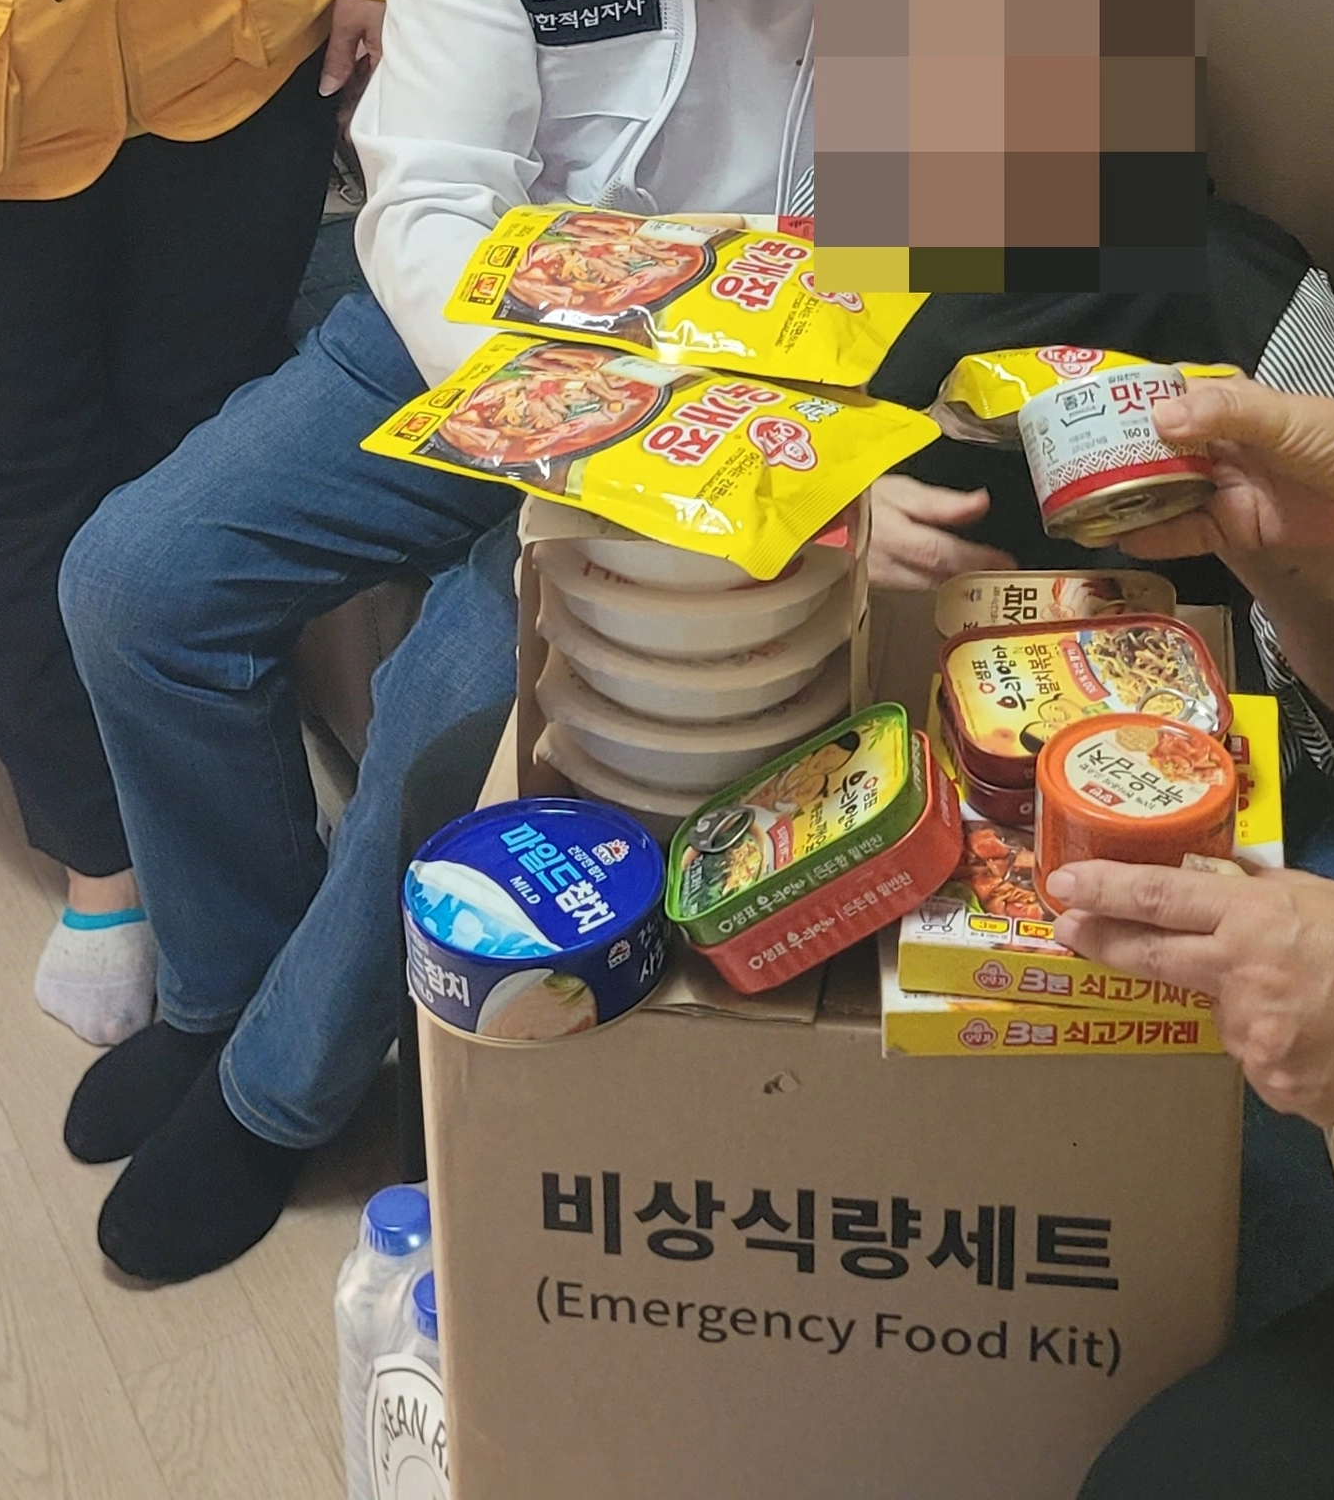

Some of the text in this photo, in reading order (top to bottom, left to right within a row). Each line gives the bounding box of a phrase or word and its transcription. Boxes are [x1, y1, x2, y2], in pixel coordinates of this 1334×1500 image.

[716, 241, 808, 308] 육개장
[648, 383, 782, 463] 육개장
[1063, 388, 1096, 411] 종가
[1123, 427, 1142, 440] 160
[1002, 584, 1038, 625] 심팜
[971, 658, 992, 681] 샘표
[992, 644, 1034, 712] 우리엄마
[1024, 643, 1060, 696] 멸치볶음
[1077, 742, 1183, 806] 볶음김치
[509, 875, 542, 906] MILD
[731, 904, 759, 931] 샘표
[812, 855, 850, 881] 든든한
[761, 939, 789, 964] 샘표
[841, 890, 879, 918] 든든한
[1018, 966, 1073, 996] 3분
[1003, 1020, 1058, 1046] 3분
[1063, 1020, 1199, 1046] 쇠고기카레
[541, 1170, 1120, 1293] 비상식량세트
[536, 1274, 1123, 1378] (Emergency Food Kit)
